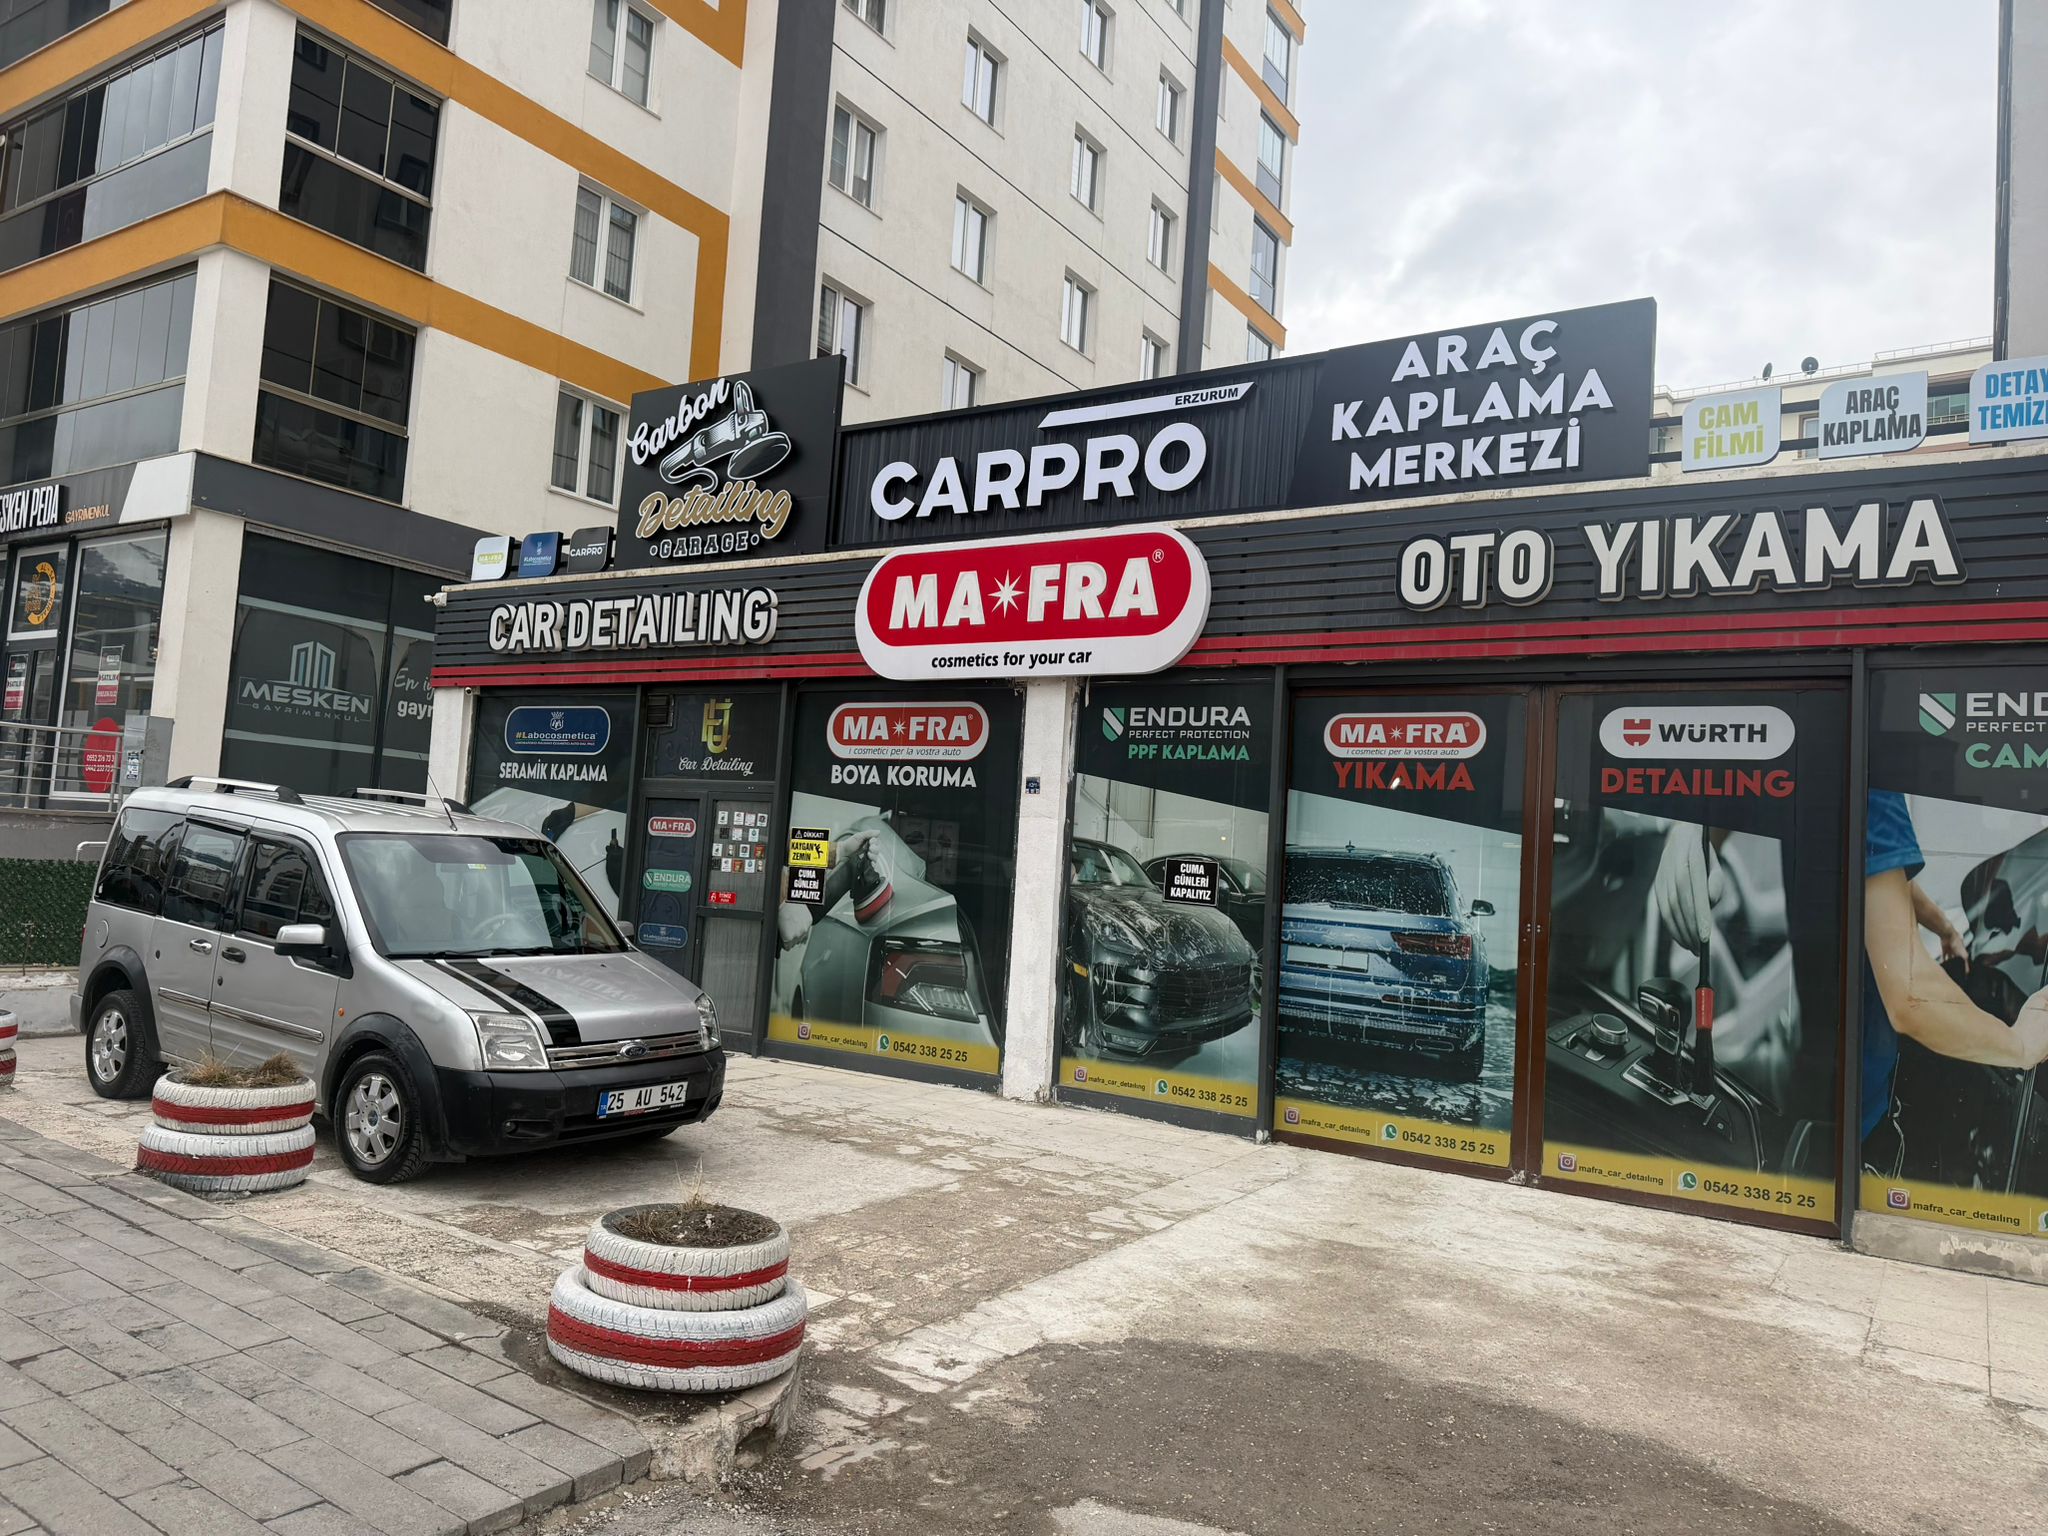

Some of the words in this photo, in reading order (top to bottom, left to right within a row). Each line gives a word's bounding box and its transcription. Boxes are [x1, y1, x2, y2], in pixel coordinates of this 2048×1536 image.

[1391, 320, 1559, 383] ARAÇ
[1174, 387, 1239, 406] ERZURUM
[1332, 368, 1614, 441] KAPLAMA
[1845, 385, 1900, 416] ARAÇ
[626, 378, 730, 465] Carbon
[1699, 401, 1759, 430] CAM
[1977, 396, 2048, 431] TEMİZ
[1823, 413, 1922, 447] KAPLAMA
[1349, 417, 1581, 490] MERKEZİ
[1693, 425, 1764, 460] FİLMİ
[870, 422, 1207, 521] CARPRO
[29, 484, 60, 527] PEDA
[635, 480, 792, 539] Detailing
[570, 546, 603, 557] CARPRO
[659, 531, 749, 558] GARAGE
[1400, 528, 1548, 608] OTO
[1584, 499, 1960, 595] YIKAMA
[489, 602, 558, 651] CAR
[565, 589, 774, 650] DETAILING
[931, 652, 998, 669] cosmetics
[1003, 651, 1025, 667] for
[1028, 651, 1065, 669] your
[1068, 650, 1092, 664] car
[394, 667, 420, 692] En
[241, 680, 369, 715] MESKEN
[252, 702, 360, 722] GAYRİMENKUL
[1129, 706, 1251, 727] ENDURA
[515, 731, 597, 740] #Labocosmetica
[1129, 730, 1176, 739] PERFECT
[1179, 730, 1250, 739] PROTECTION
[1658, 723, 1768, 743] WÜRTH
[1966, 721, 2047, 733] PERFECT
[853, 747, 888, 756] cosmetici
[890, 748, 905, 757] per
[906, 747, 914, 755] la
[916, 748, 940, 756] vostra
[942, 748, 962, 756] auto
[1128, 744, 1158, 760] PPF
[1162, 744, 1250, 761] KAPLAMA
[1351, 748, 1387, 756] cosmetici
[1388, 749, 1401, 757] per
[1965, 742, 2048, 769] CAM
[499, 758, 547, 780] SERAMİK
[550, 762, 608, 782] KAPLAMA
[678, 756, 697, 770] Car
[701, 756, 754, 775] Detailing
[831, 764, 881, 786] BOYA
[887, 765, 977, 788] KORUMA
[1333, 761, 1476, 791] YIKAMA
[1601, 767, 1796, 798] DETAILING
[791, 842, 814, 851] KAYGAN
[803, 831, 825, 839] DİKKAT!
[792, 852, 811, 862] ZEMİN
[654, 873, 691, 883] ENDURA
[798, 869, 816, 879] CUMA
[1174, 873, 1209, 888] GÜNLERİ
[1180, 863, 1205, 875] CUMA
[791, 889, 821, 900] KAPALIYIZ
[794, 878, 819, 890] GÜNLERİ
[1170, 887, 1211, 901] KAPALIYIZ
[893, 1041, 917, 1055] 0542
[919, 1045, 937, 1058] 338
[940, 1047, 952, 1060] 25
[955, 1050, 968, 1063] 25
[608, 1092, 624, 1111] 25
[635, 1088, 652, 1107] AU
[660, 1084, 684, 1103] 542
[1172, 1085, 1195, 1099] 0542
[1198, 1088, 1216, 1102] 338
[1219, 1093, 1233, 1106] 25
[1235, 1095, 1248, 1108] 25
[1402, 1130, 1431, 1145] 0542
[1434, 1135, 1456, 1150] 338
[1460, 1139, 1476, 1153] 25
[1479, 1142, 1495, 1155] 25
[1703, 1180, 1738, 1197] 0542
[1743, 1186, 1770, 1201] 338
[1775, 1190, 1792, 1205] 25
[1796, 1194, 1816, 1209] 25
